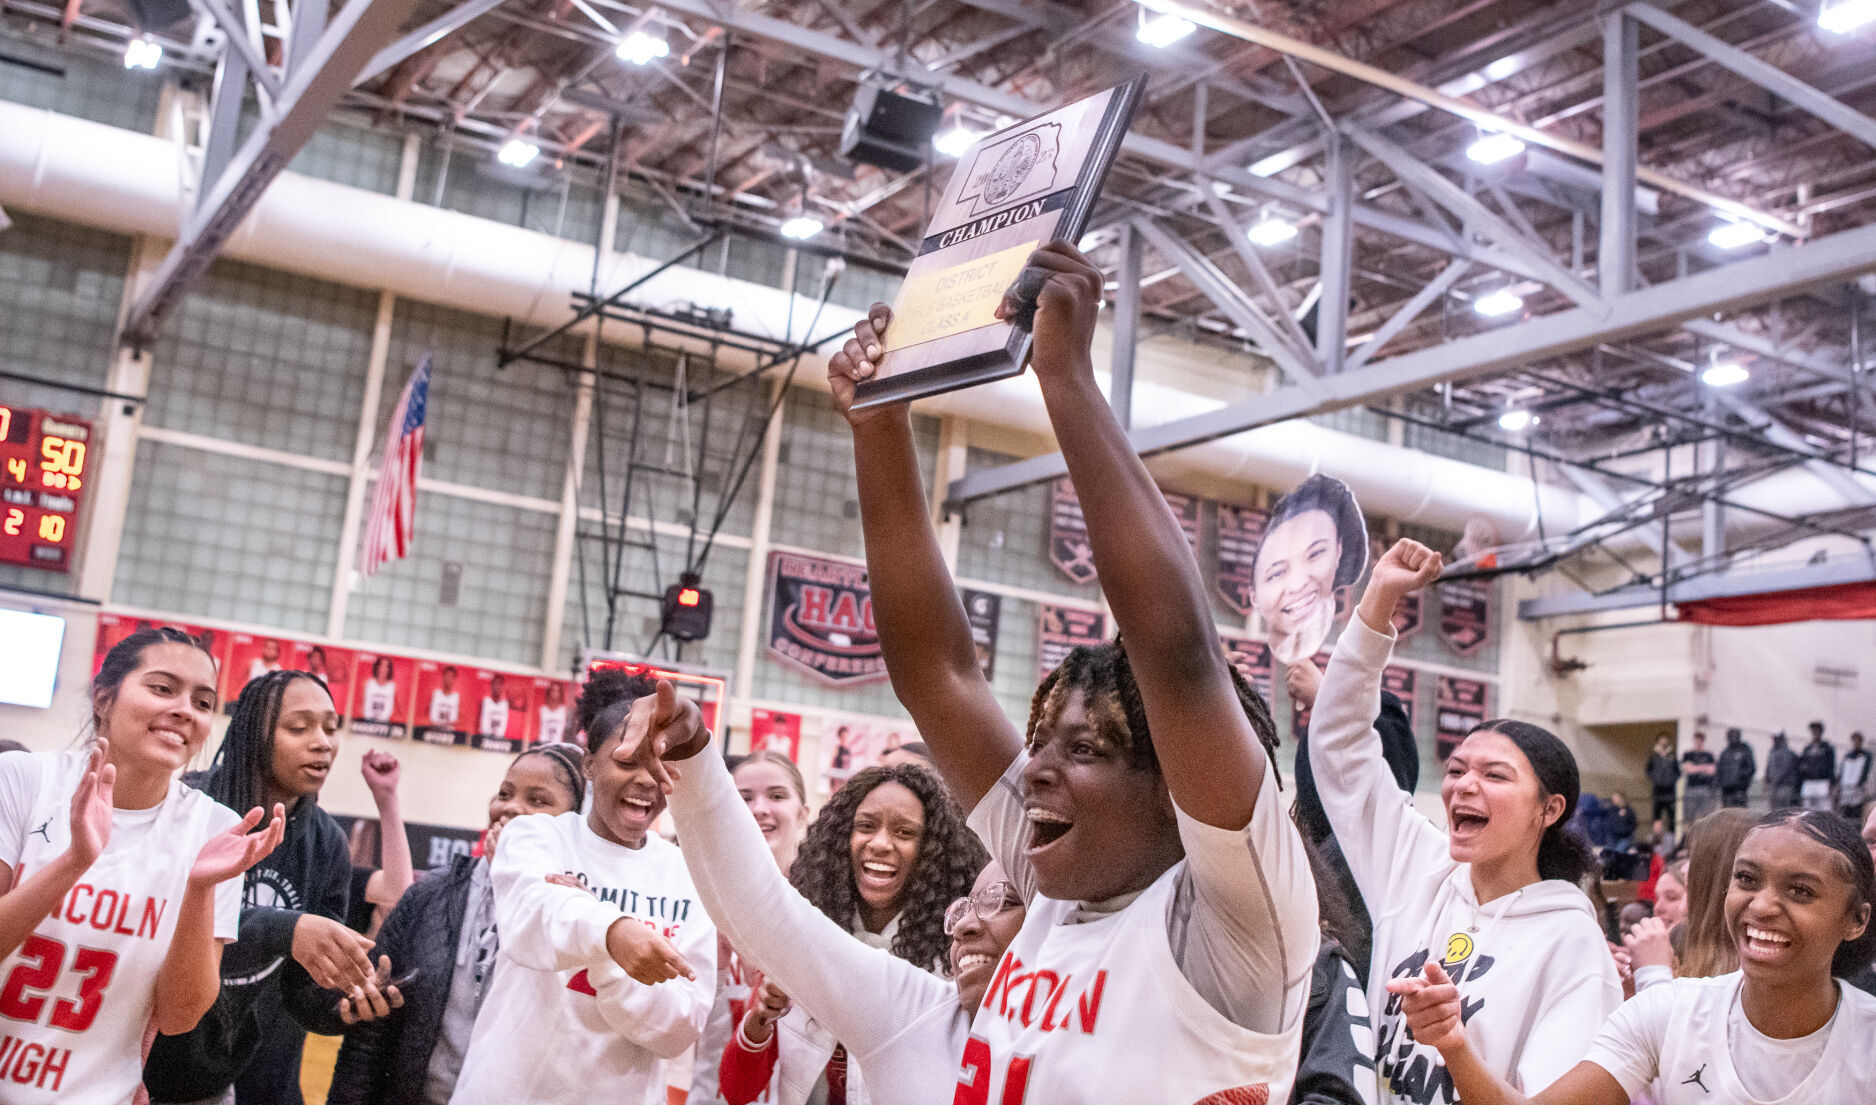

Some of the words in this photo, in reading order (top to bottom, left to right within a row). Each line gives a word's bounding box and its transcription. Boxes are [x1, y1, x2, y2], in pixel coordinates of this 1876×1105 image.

[940, 199, 1047, 248] CHAMPION
[934, 261, 999, 292] DISTRICT
[935, 279, 1006, 312] BASKETBAL
[8, 457, 27, 483] 4
[40, 436, 87, 476] 50
[4, 508, 24, 536] 2
[38, 514, 66, 543] 10
[10, 863, 168, 940] COLN
[564, 870, 639, 914] OMIT
[672, 899, 691, 922] IT
[0, 935, 120, 1033] 23
[983, 951, 1109, 1035] NCOLN
